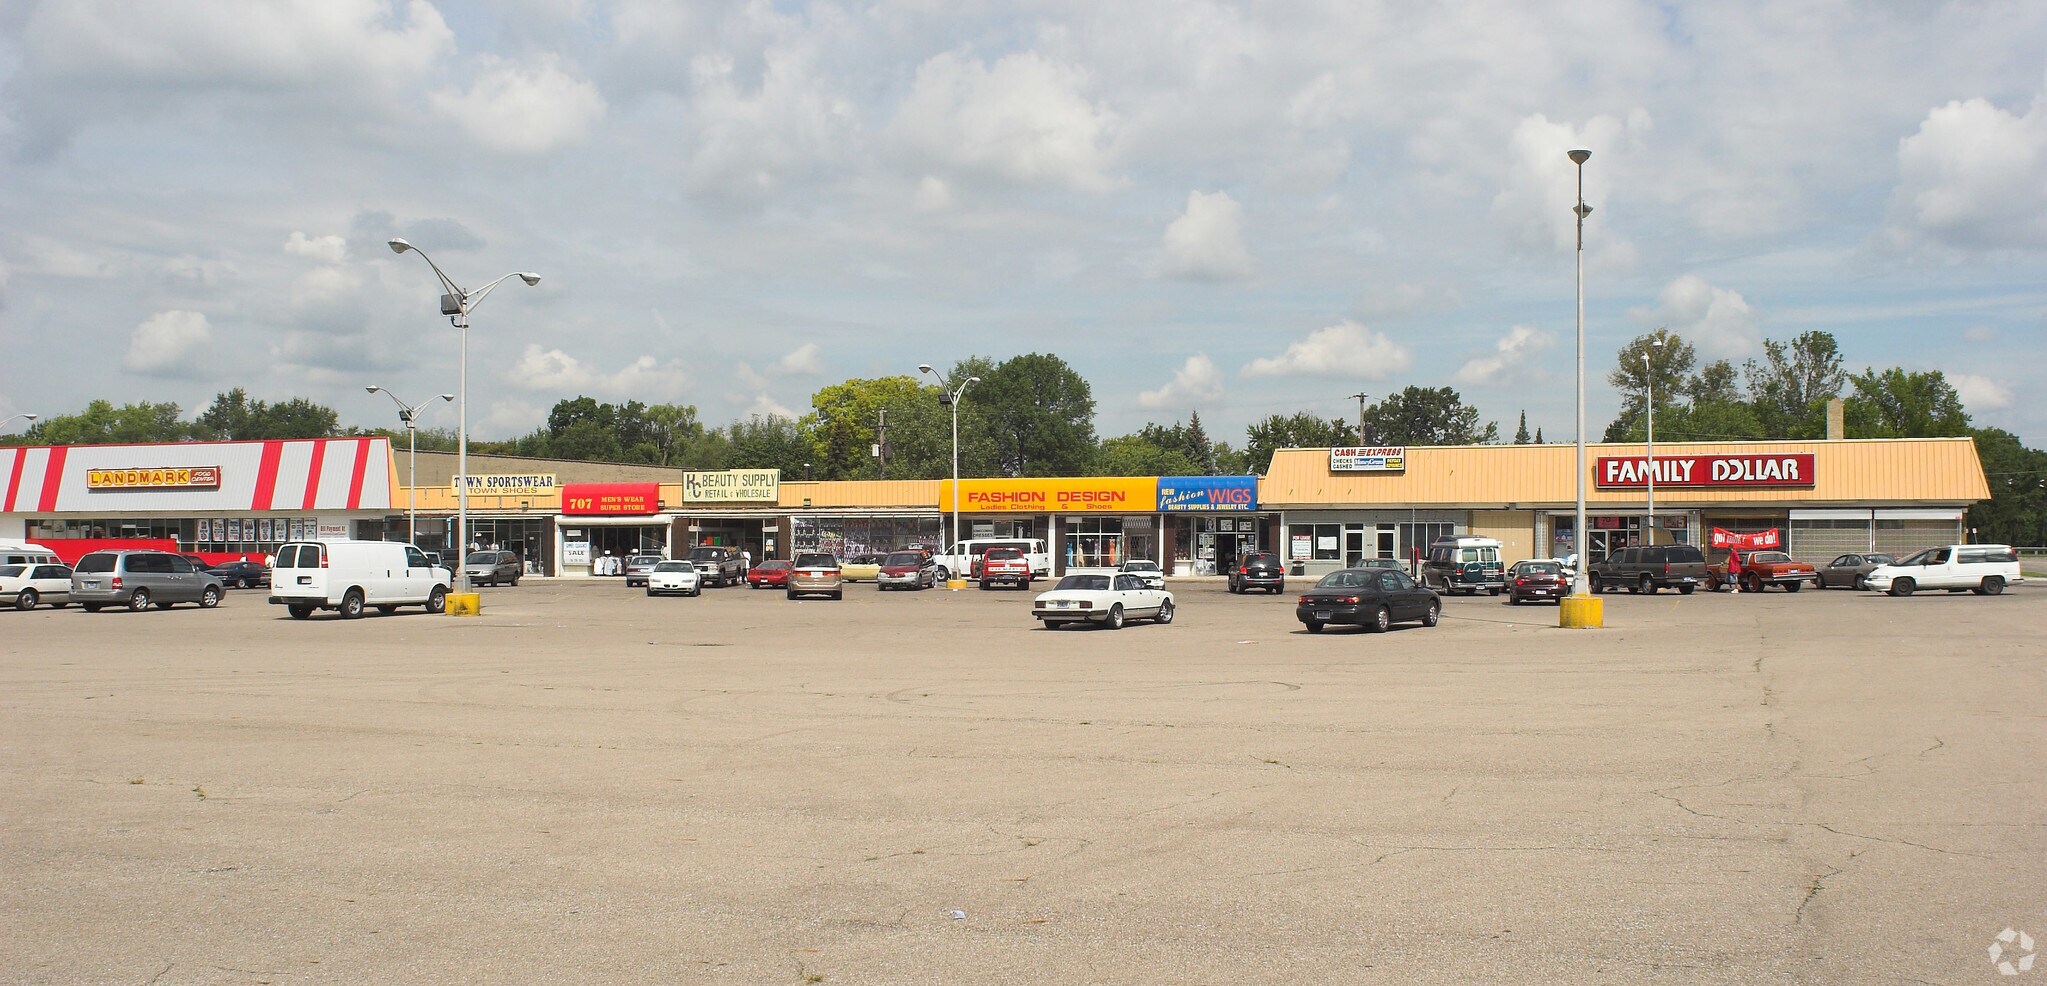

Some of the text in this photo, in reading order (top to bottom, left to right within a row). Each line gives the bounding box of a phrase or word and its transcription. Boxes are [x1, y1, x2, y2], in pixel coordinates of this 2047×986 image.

[1334, 448, 1402, 457] CASH EXPRESS
[91, 469, 188, 484] LANDMARK
[1606, 458, 1799, 482] FAMILY DOLLAR
[454, 475, 553, 488] TWN SPORTSWEAR
[702, 473, 776, 487] BEAUTY SUPPLY
[704, 489, 728, 498] RETAIL
[735, 488, 771, 498] WHOLESALE
[968, 491, 1126, 503] FASHION DESIGN
[1161, 488, 1175, 496] NEW
[1207, 488, 1252, 504] WIGS
[569, 498, 593, 510] 707
[1160, 490, 1205, 509] fashion
[1714, 532, 1726, 545] got
[1753, 536, 1764, 545] we
[1764, 532, 1777, 544] do!
